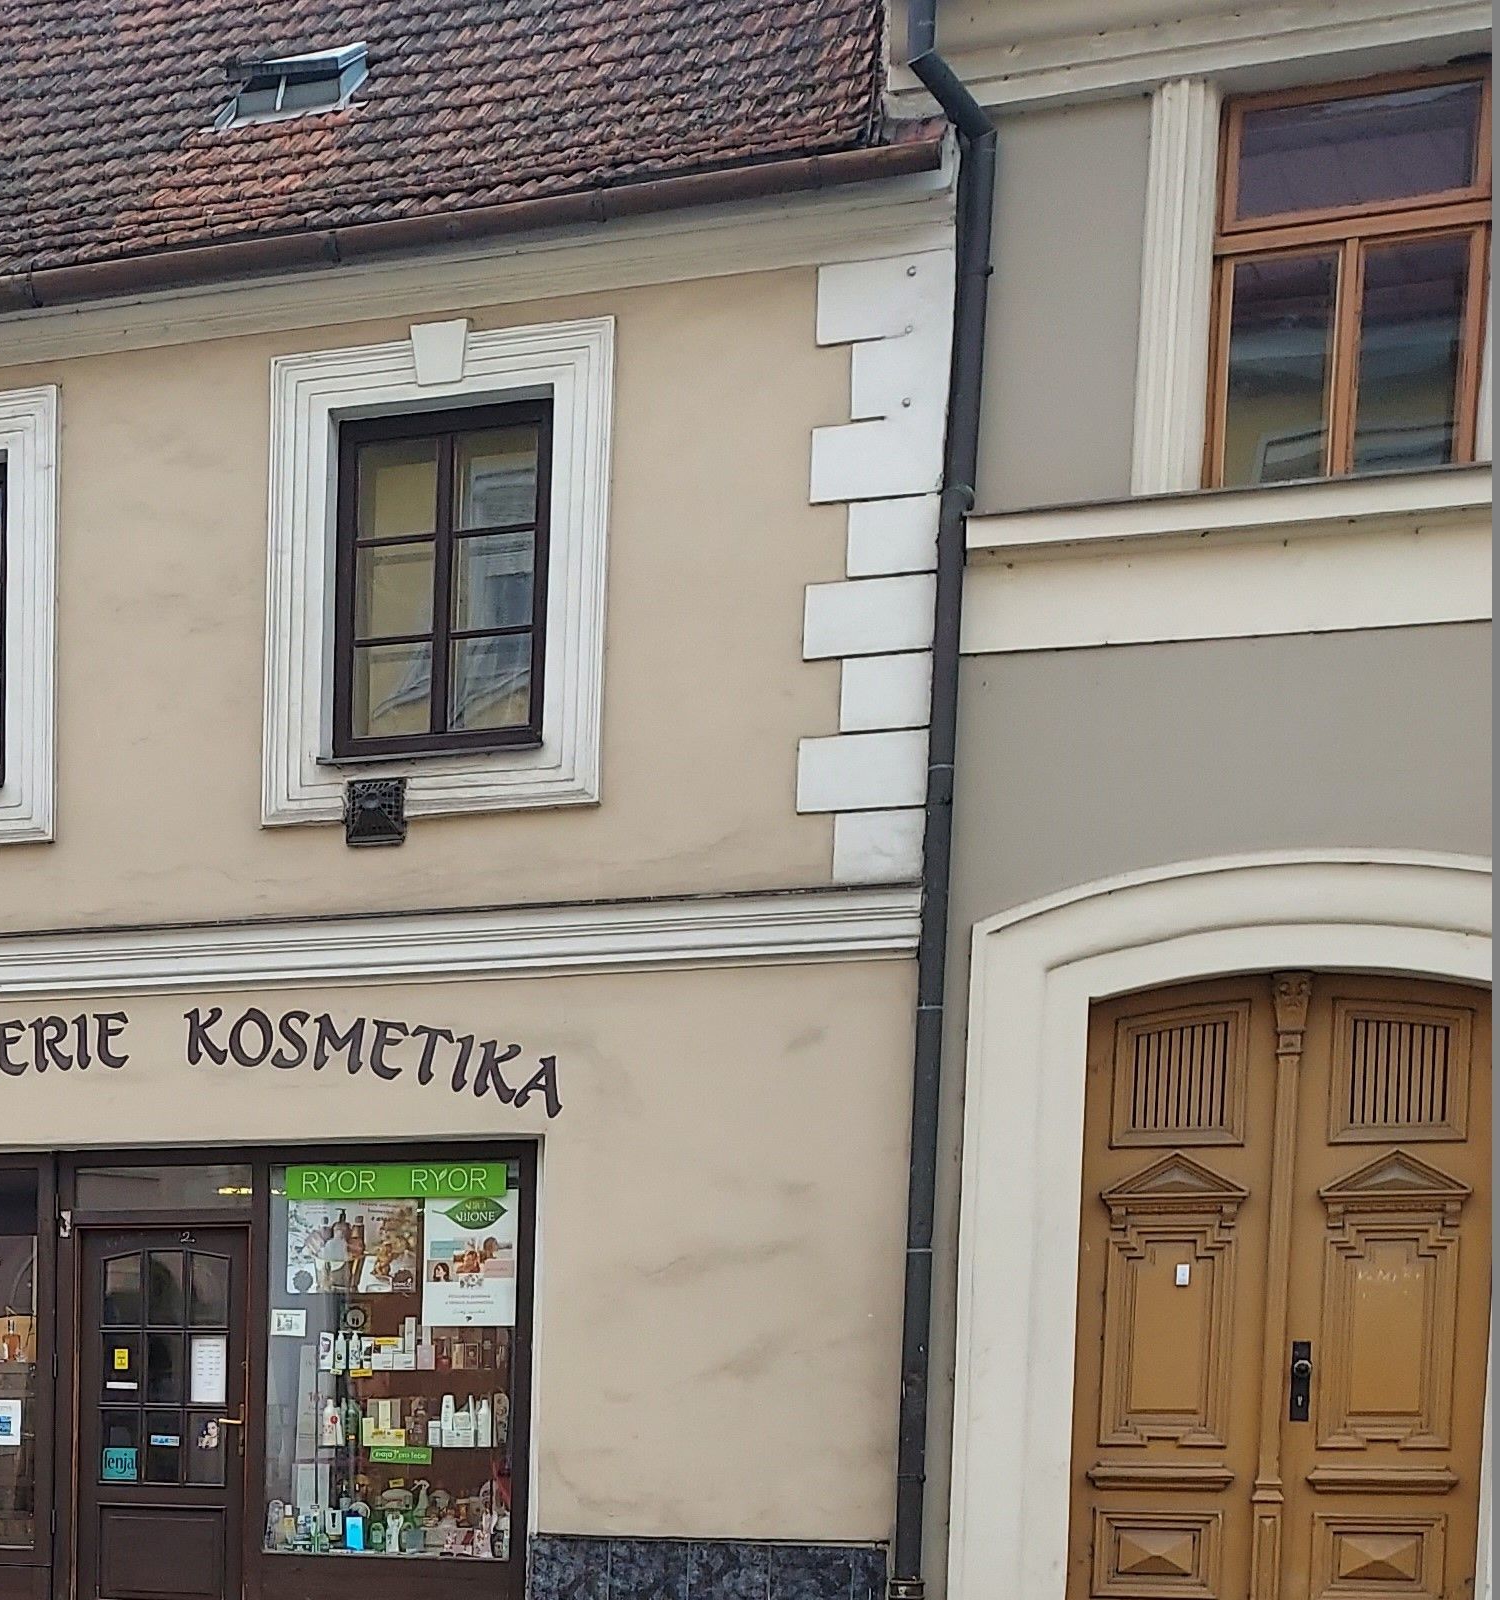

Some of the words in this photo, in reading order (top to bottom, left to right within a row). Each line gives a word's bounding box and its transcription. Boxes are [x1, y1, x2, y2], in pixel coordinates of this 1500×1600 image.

[183, 1007, 563, 1119] KOSMETIKA
[302, 1169, 376, 1194] RYOR
[411, 1167, 488, 1192] RYOR
